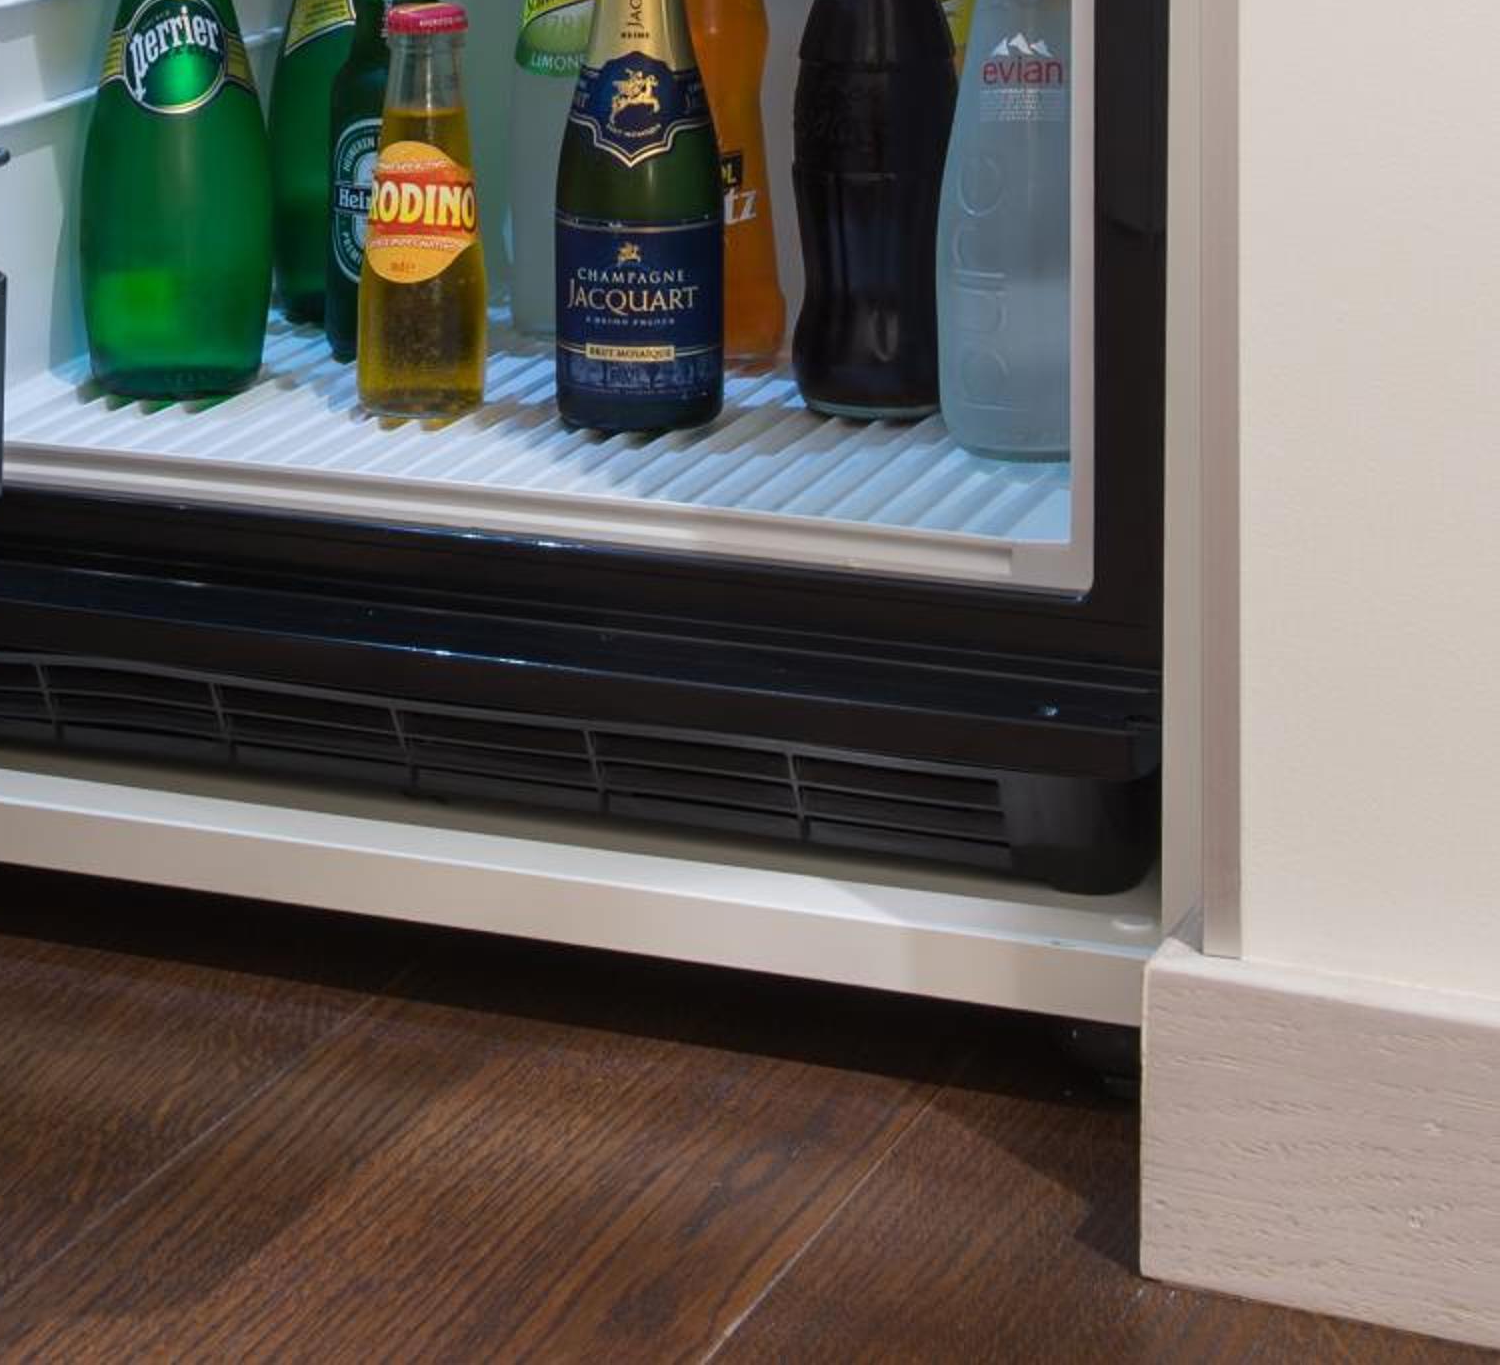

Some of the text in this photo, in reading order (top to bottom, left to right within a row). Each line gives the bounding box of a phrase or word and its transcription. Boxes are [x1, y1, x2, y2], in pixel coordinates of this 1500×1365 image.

[983, 56, 1063, 86] evian
[368, 180, 476, 230] RODINO
[577, 266, 685, 284] CHAMPAGNE
[562, 277, 699, 316] JACQUART
